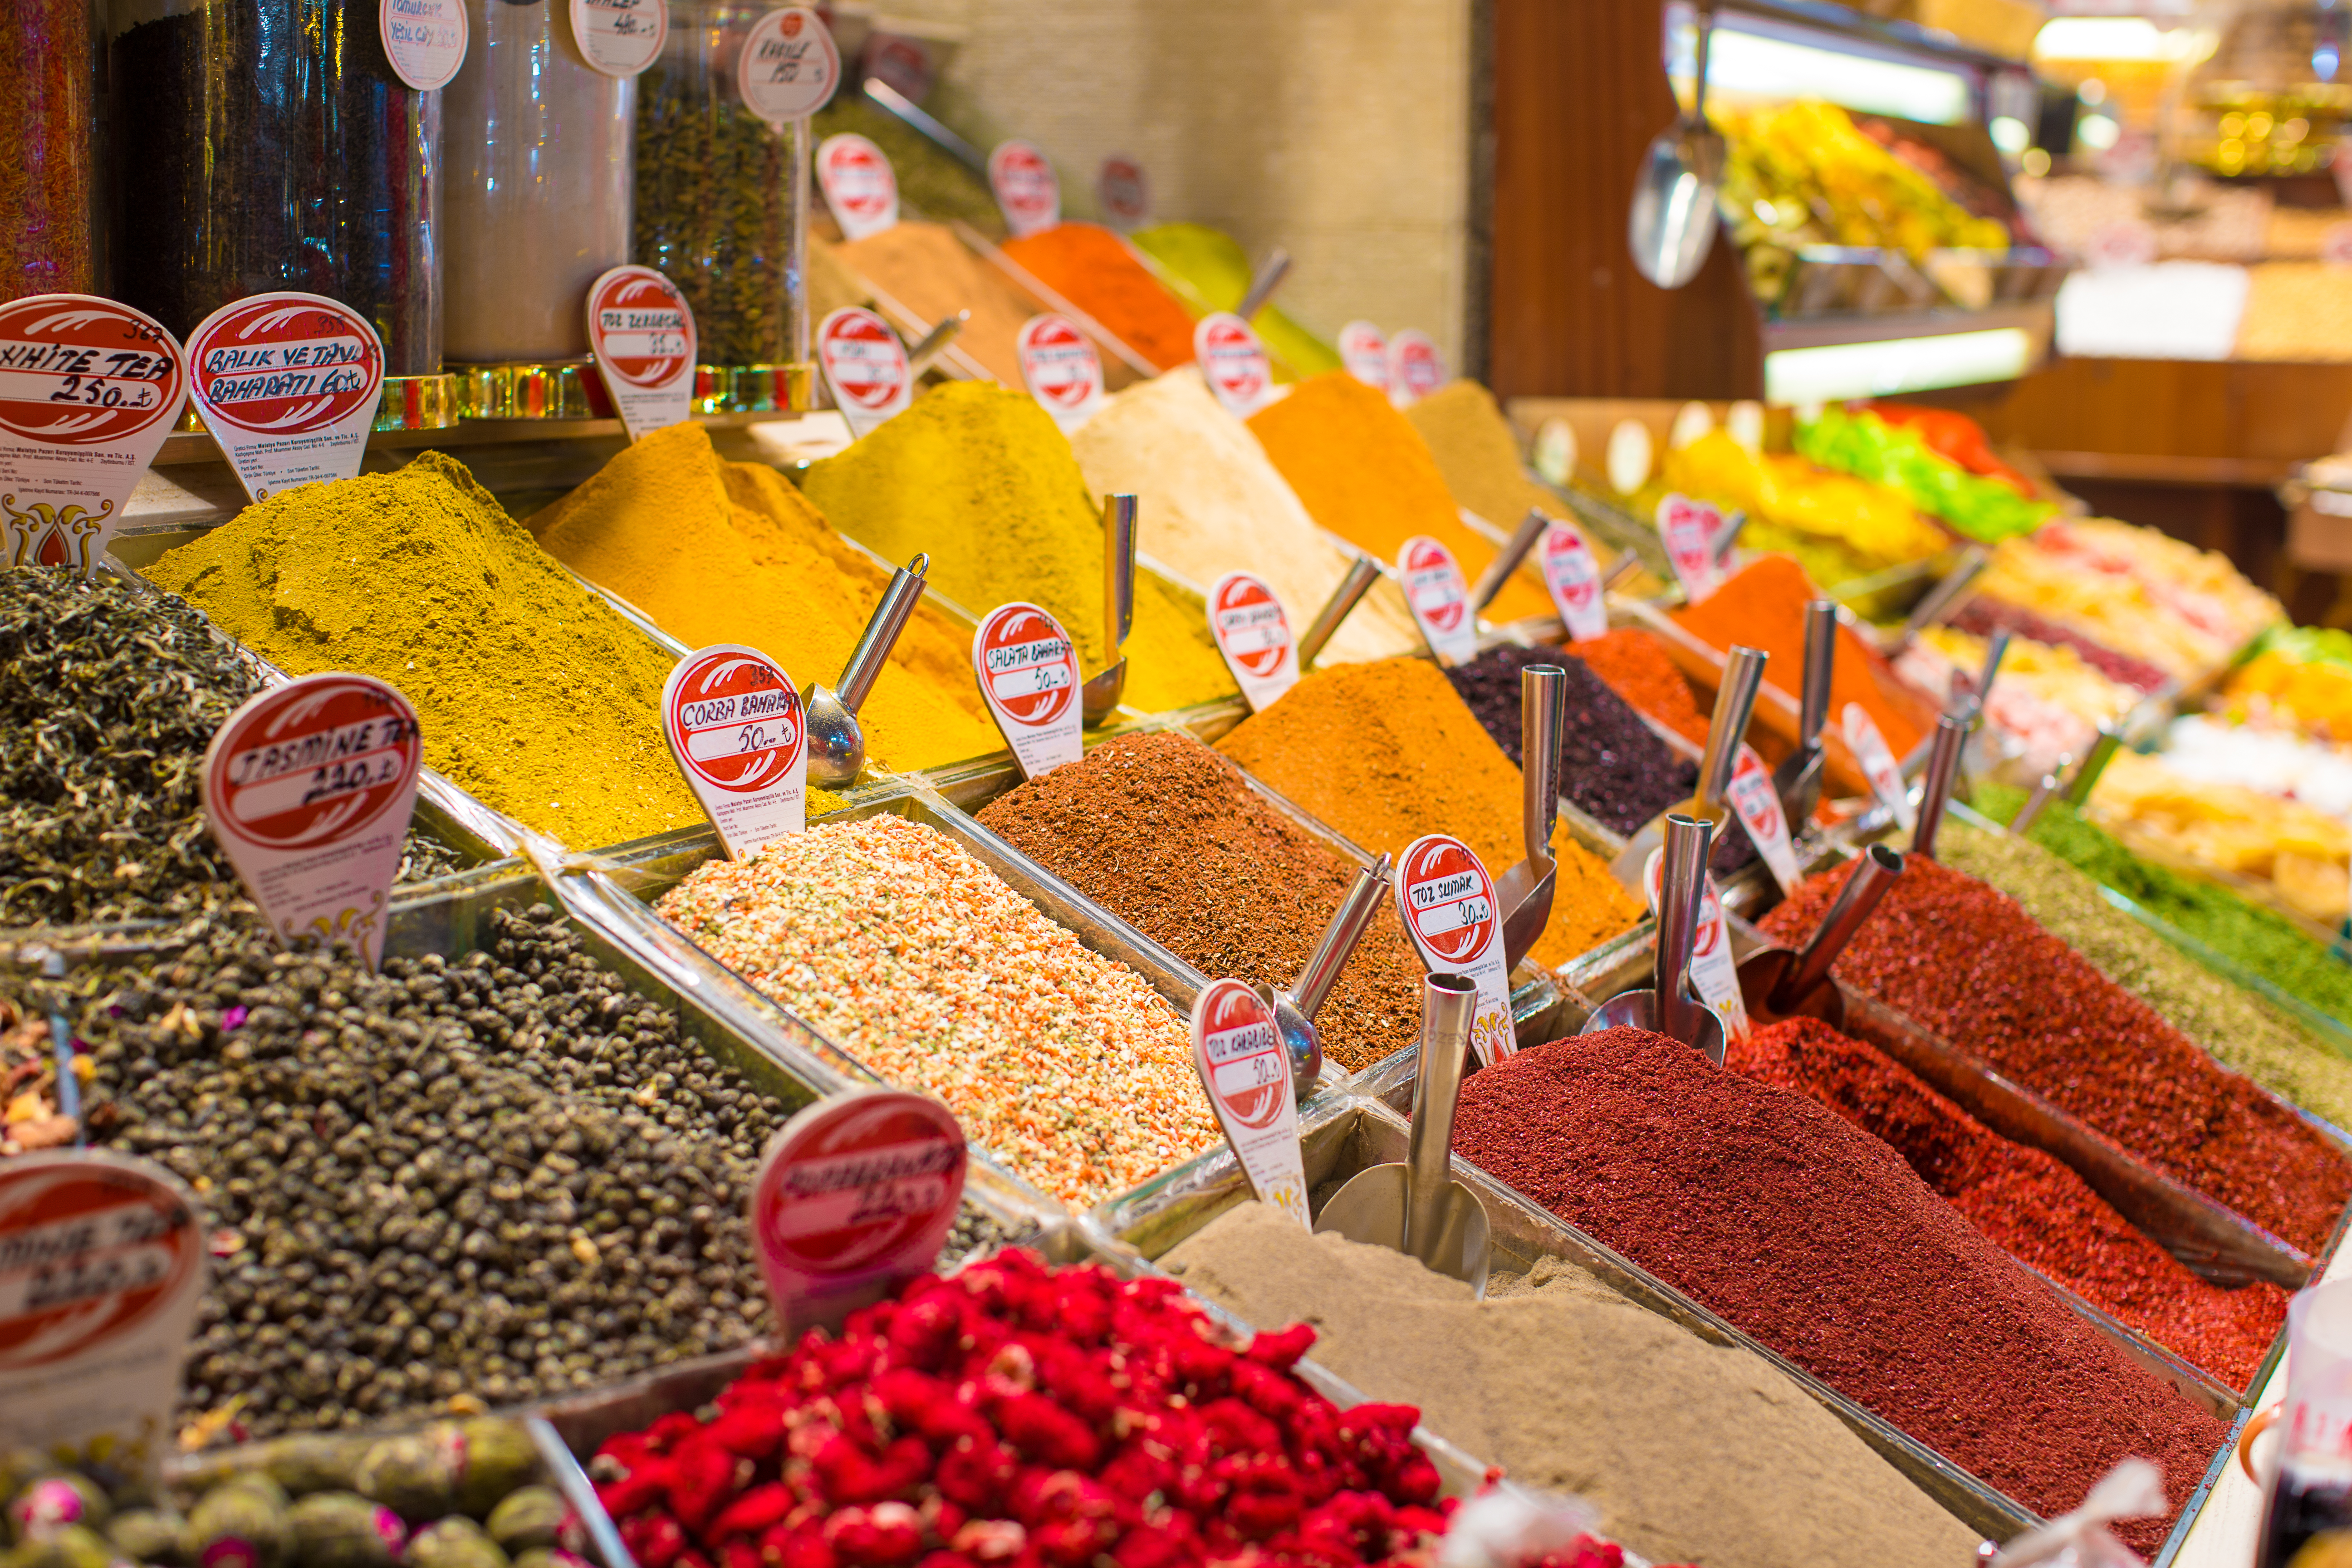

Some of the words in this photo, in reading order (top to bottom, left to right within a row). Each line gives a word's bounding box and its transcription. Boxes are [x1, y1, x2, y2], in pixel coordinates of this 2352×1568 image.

[104, 353, 175, 380] TEA
[206, 349, 275, 374] BALIK
[283, 346, 310, 366] VE
[209, 372, 317, 405] BAHARATI
[989, 645, 1028, 669] SALATA
[1412, 886, 1436, 906] TOZ
[1437, 875, 1474, 899] SUMAK
